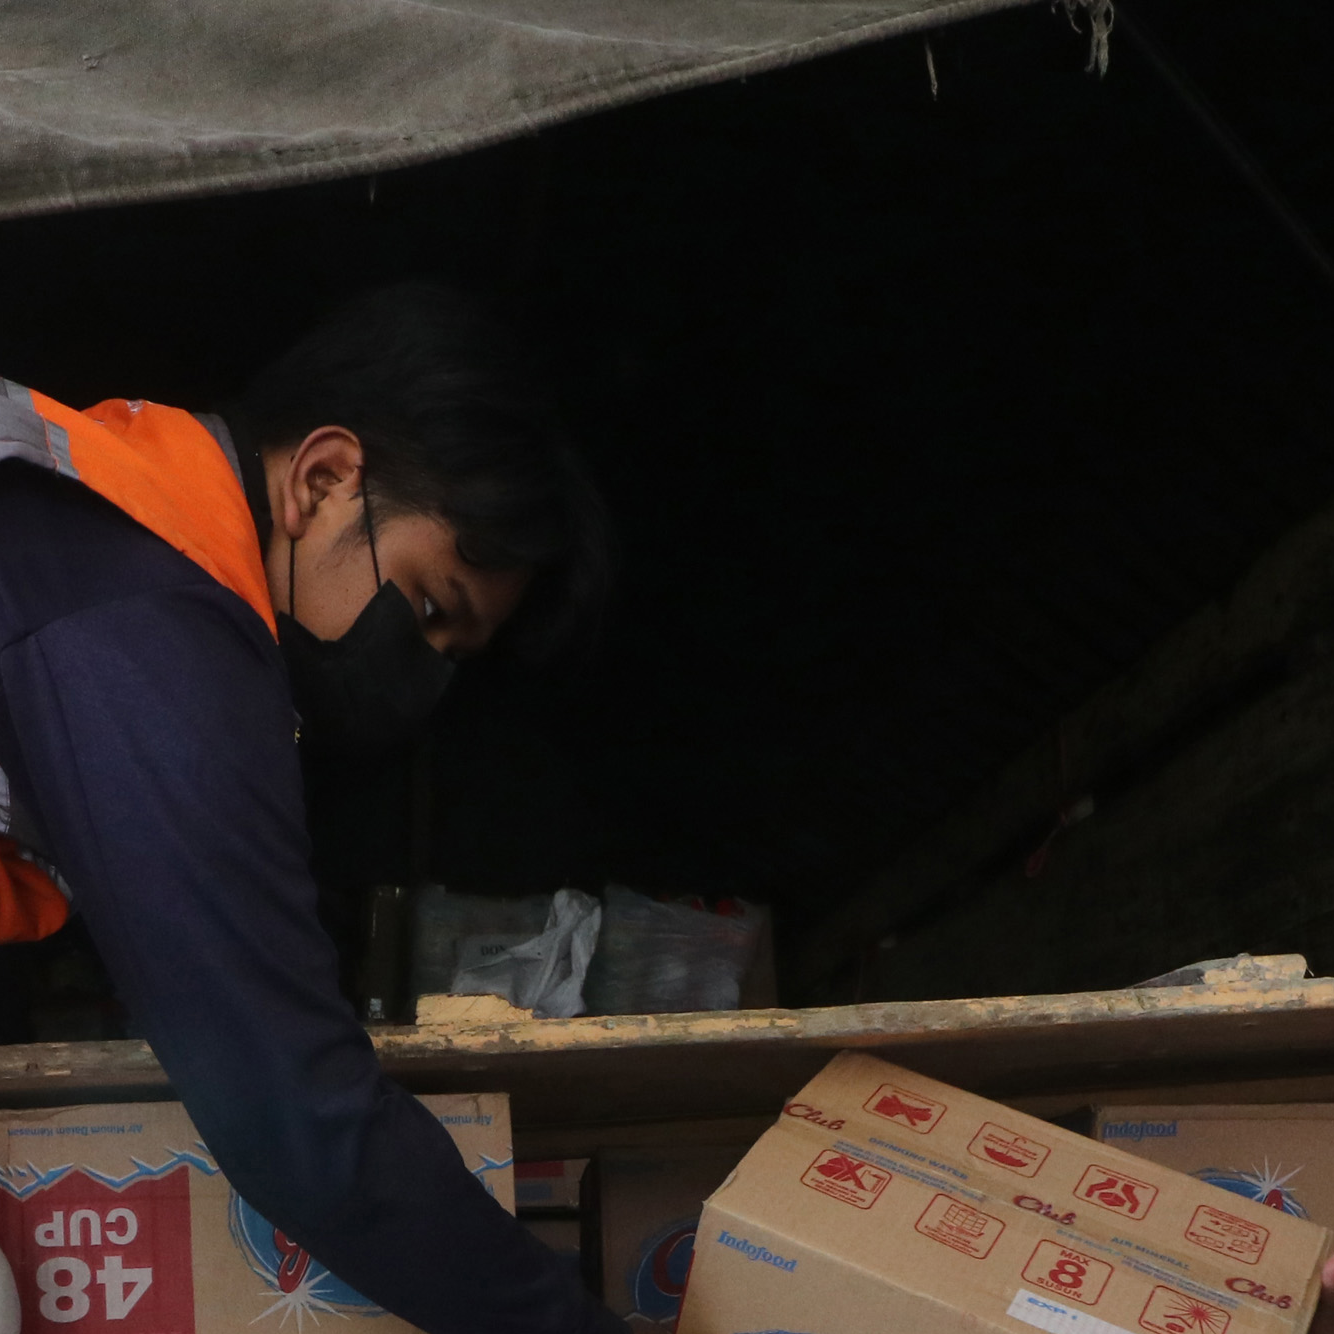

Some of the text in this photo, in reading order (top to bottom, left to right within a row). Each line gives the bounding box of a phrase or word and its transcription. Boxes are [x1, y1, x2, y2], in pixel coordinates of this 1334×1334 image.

[783, 1103, 845, 1131] Club
[1102, 1120, 1179, 1141] Indofood
[1012, 1194, 1077, 1226] Club
[35, 1207, 138, 1248] CUP
[717, 1230, 798, 1272] Indofood
[1059, 1249, 1091, 1268] MAX
[35, 1255, 153, 1324] 48
[1036, 1276, 1083, 1300] SUSUN
[1047, 1258, 1087, 1290] 8
[1224, 1277, 1293, 1310] Club
